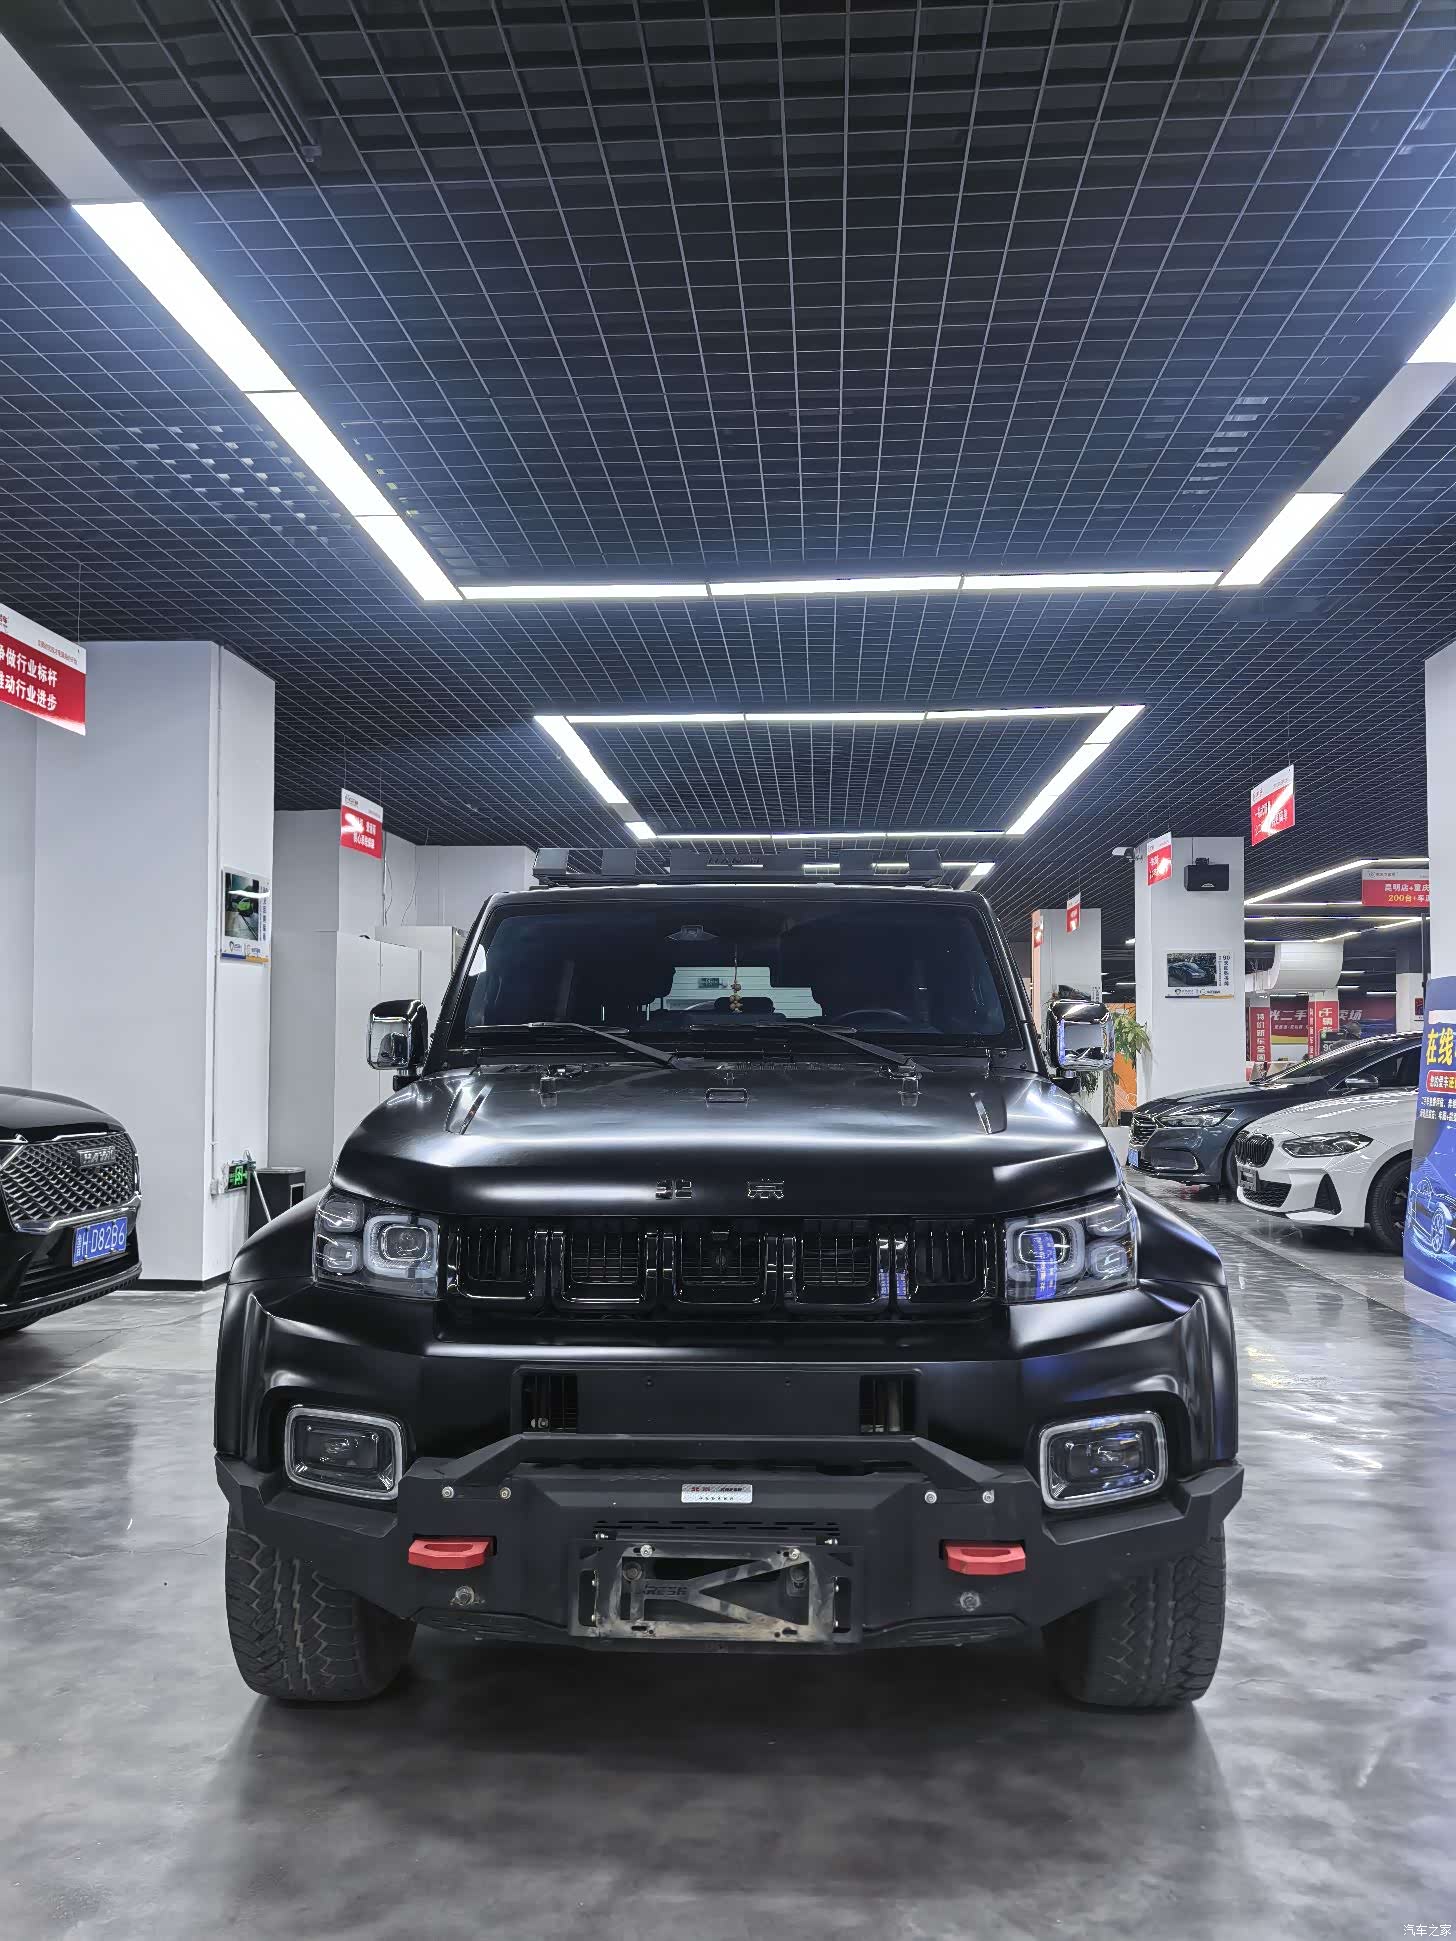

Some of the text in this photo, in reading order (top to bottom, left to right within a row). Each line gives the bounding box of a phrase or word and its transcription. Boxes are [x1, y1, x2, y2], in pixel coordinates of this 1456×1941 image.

[1425, 1027, 1456, 1066] 在线
[1429, 1075, 1456, 1089] 您的爱车还
